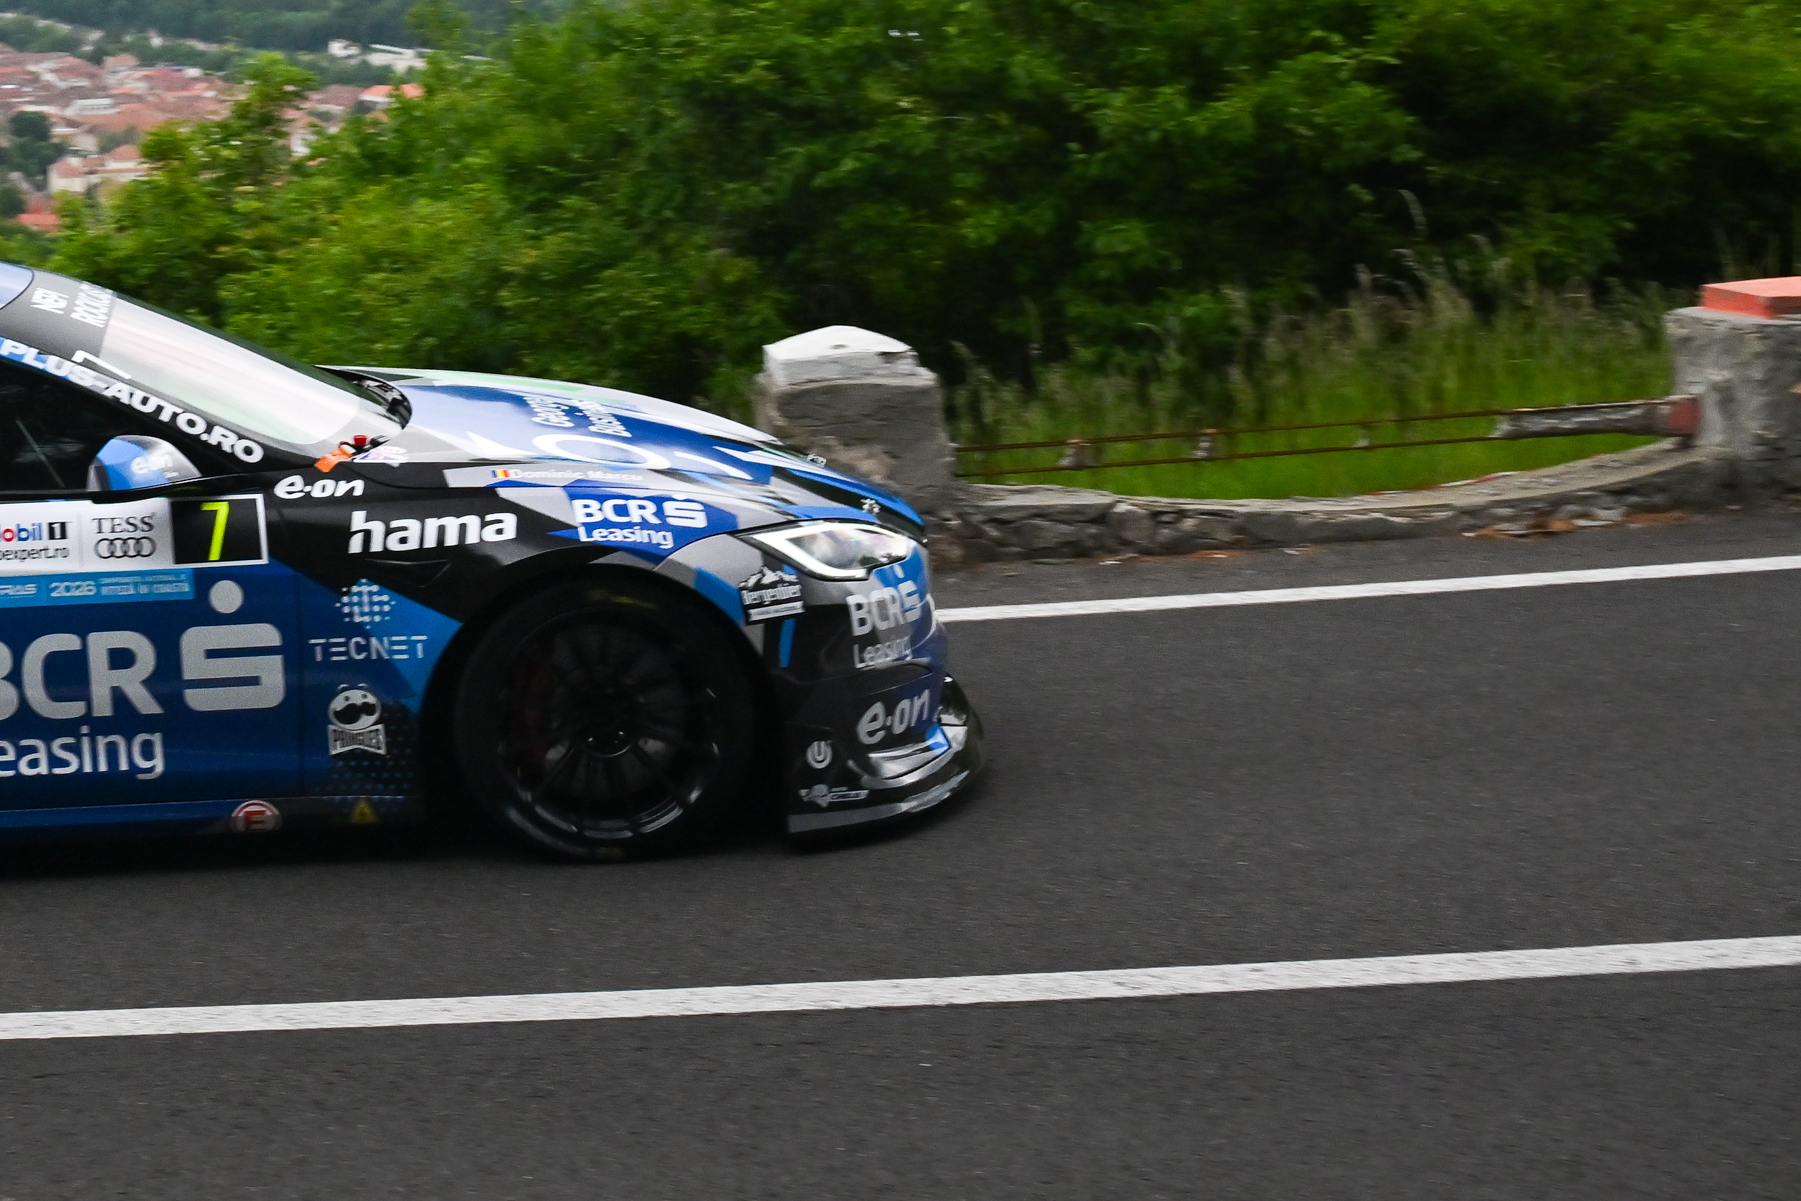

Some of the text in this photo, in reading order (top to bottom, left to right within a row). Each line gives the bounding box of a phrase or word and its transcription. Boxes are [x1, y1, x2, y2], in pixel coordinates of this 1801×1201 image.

[570, 499, 661, 525] BCR
[92, 517, 154, 535] TESS
[200, 502, 230, 561] 7
[348, 510, 518, 554] hama
[577, 525, 675, 550] Leasing
[49, 580, 97, 597] 2026
[308, 635, 429, 661] TECNET
